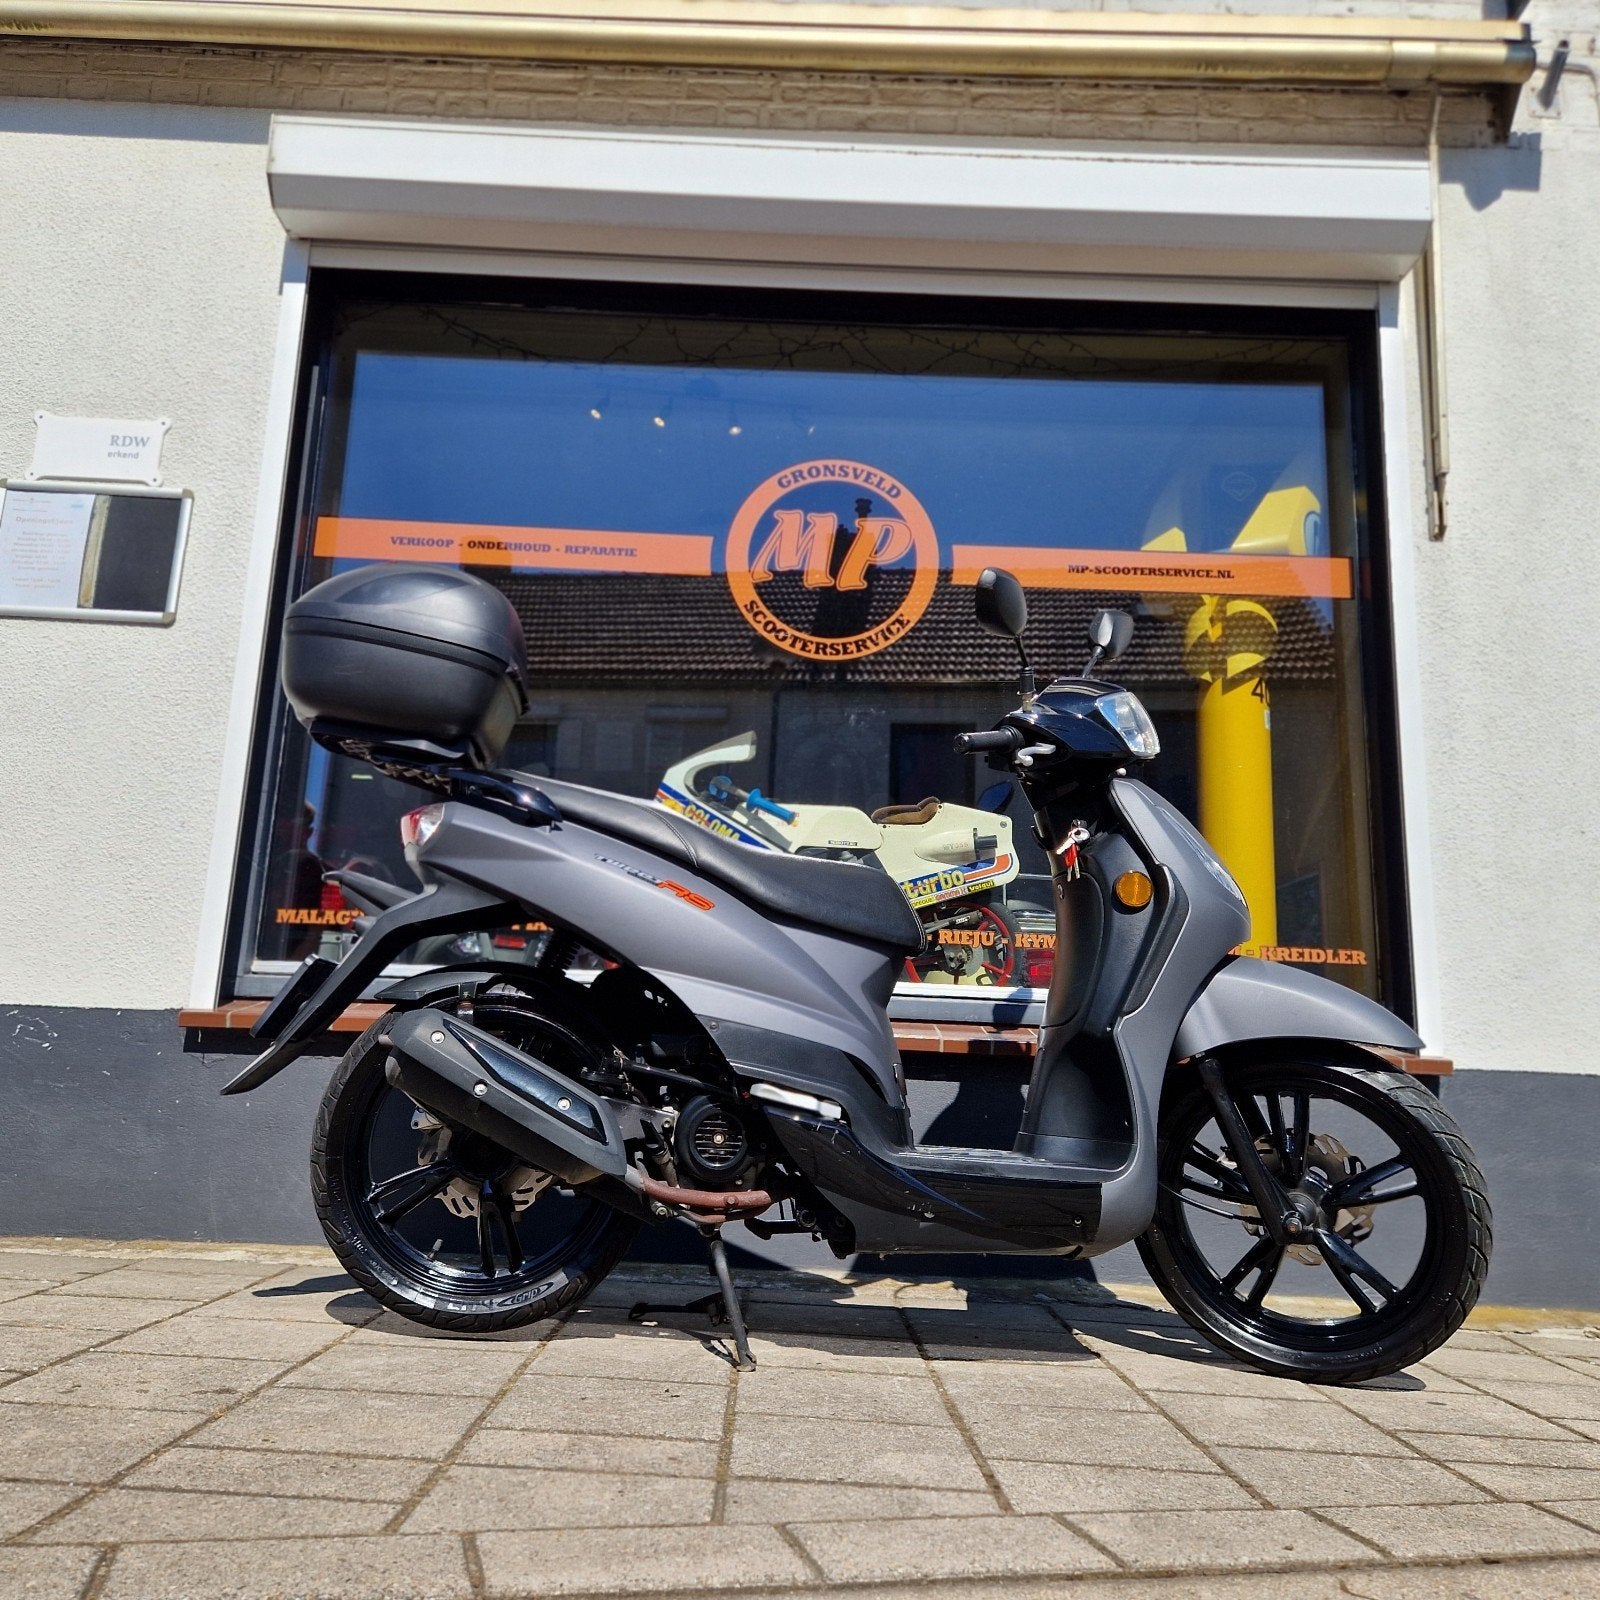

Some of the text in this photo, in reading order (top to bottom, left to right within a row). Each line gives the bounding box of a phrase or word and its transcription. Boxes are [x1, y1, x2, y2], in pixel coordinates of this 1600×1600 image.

[107, 450, 140, 460] erkend
[110, 434, 151, 448] RDW
[777, 464, 901, 499] GRONSVELD
[390, 536, 455, 548] VERKOOP
[467, 540, 551, 553] ONDERHOUD
[564, 544, 638, 557] REPARATIE
[750, 509, 914, 591] MP
[1068, 564, 1235, 579] MP-SCOOTERSERVICE.NL
[744, 600, 911, 656] SCOOTERSERVICE
[657, 880, 716, 911] RS
[902, 870, 966, 899] turbo
[939, 929, 996, 948] RIEJU
[1260, 946, 1367, 964] KREIDLER
